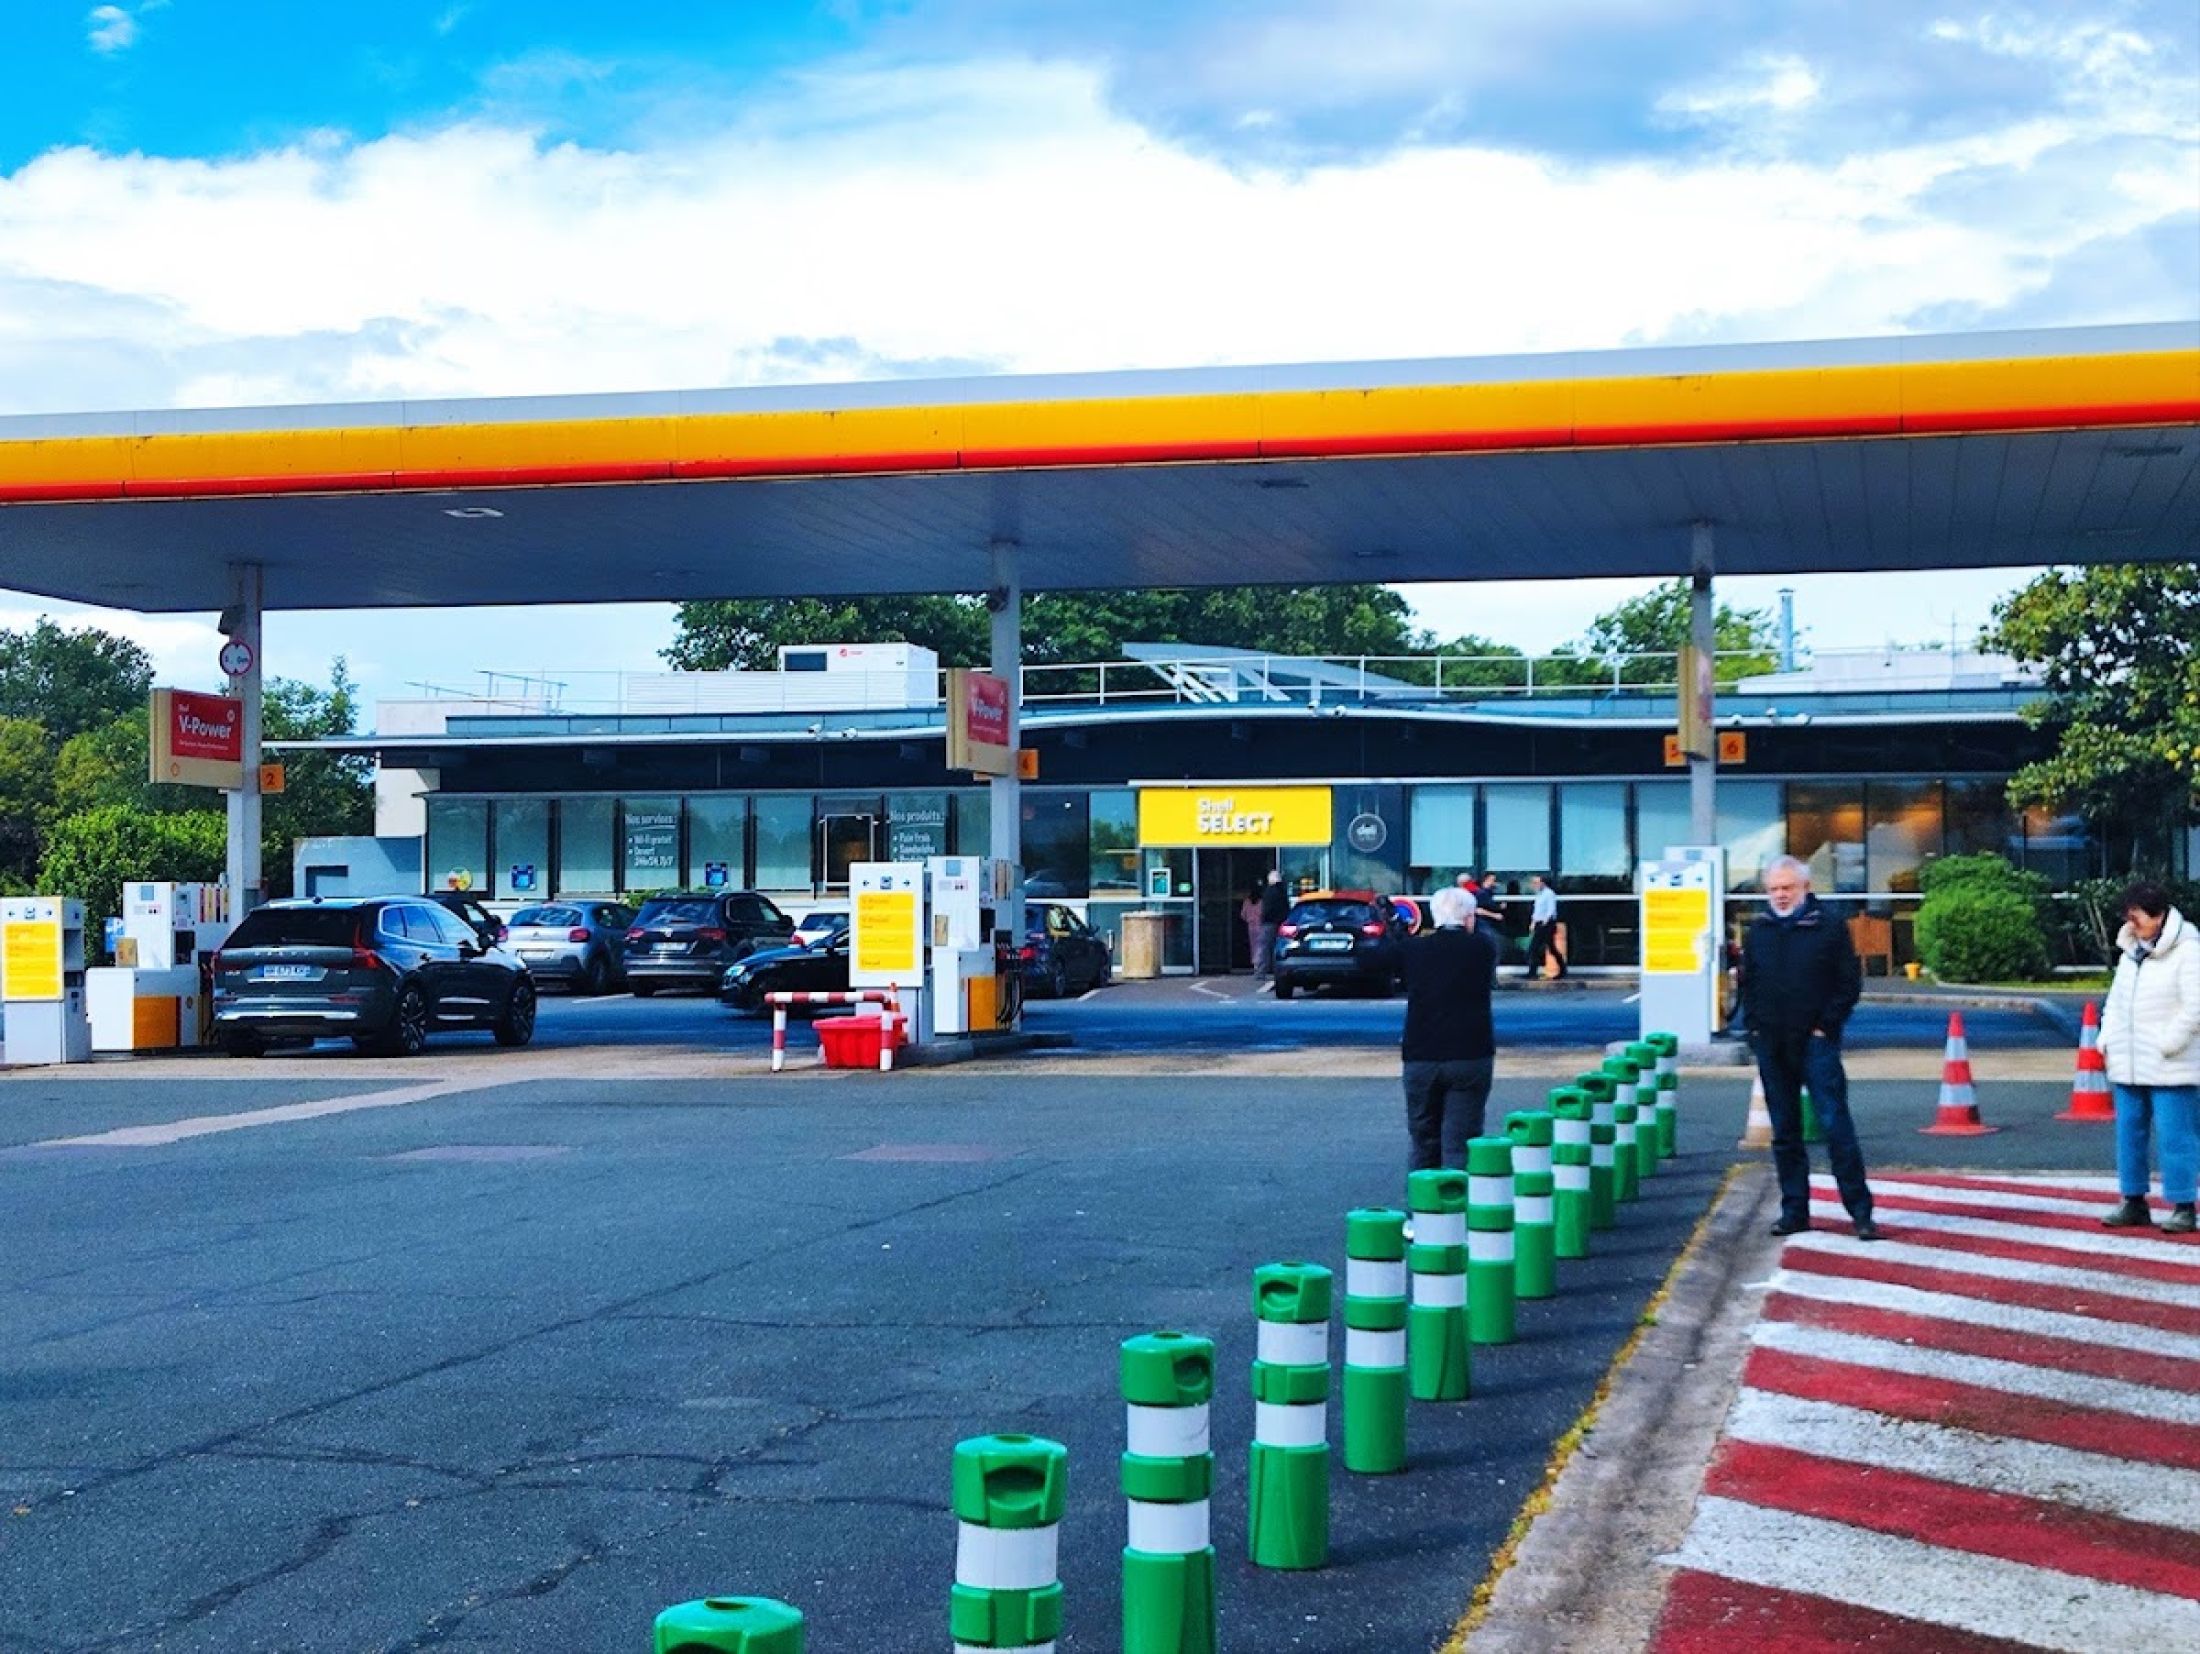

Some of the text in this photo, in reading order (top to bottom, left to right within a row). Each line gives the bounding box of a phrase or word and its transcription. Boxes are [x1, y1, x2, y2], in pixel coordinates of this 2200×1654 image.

[178, 715, 232, 739] V-Power
[1726, 741, 1740, 755] 6
[265, 772, 275, 786] 2
[1199, 798, 1234, 814] Shell
[625, 814, 641, 825] Nos
[890, 811, 905, 822] Nos
[1199, 814, 1273, 835] SELECT
